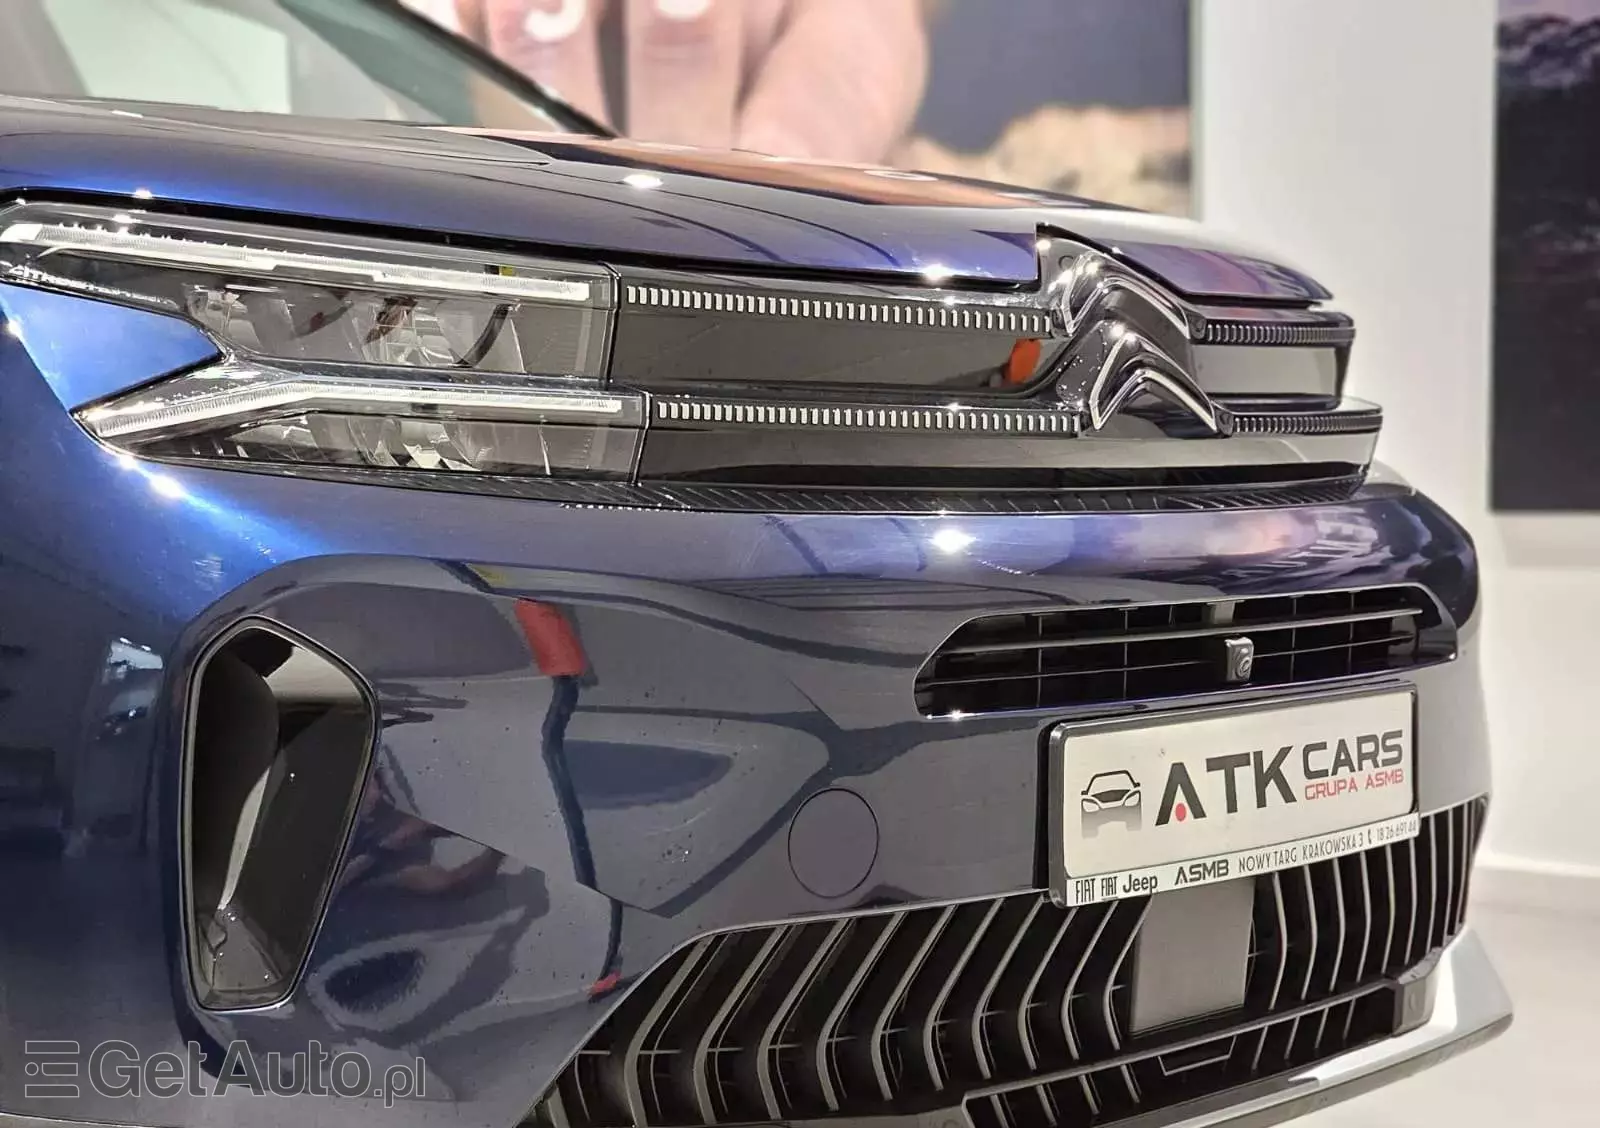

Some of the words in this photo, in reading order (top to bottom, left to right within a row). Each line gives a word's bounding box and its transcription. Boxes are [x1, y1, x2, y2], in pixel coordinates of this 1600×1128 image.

[1155, 746, 1298, 826] ATK
[1302, 729, 1404, 780] CARS
[1304, 777, 1359, 801] GRUPA
[1365, 768, 1404, 790] ASMB
[1075, 878, 1096, 904] FIAT
[1101, 876, 1118, 898] FIAT
[1122, 873, 1158, 894] Jeep
[1174, 859, 1230, 886] ASMB
[1238, 853, 1271, 873] NOWY
[1273, 847, 1298, 867] TARG
[1302, 834, 1357, 861] KRAKOWSKA
[1359, 832, 1364, 848] 3
